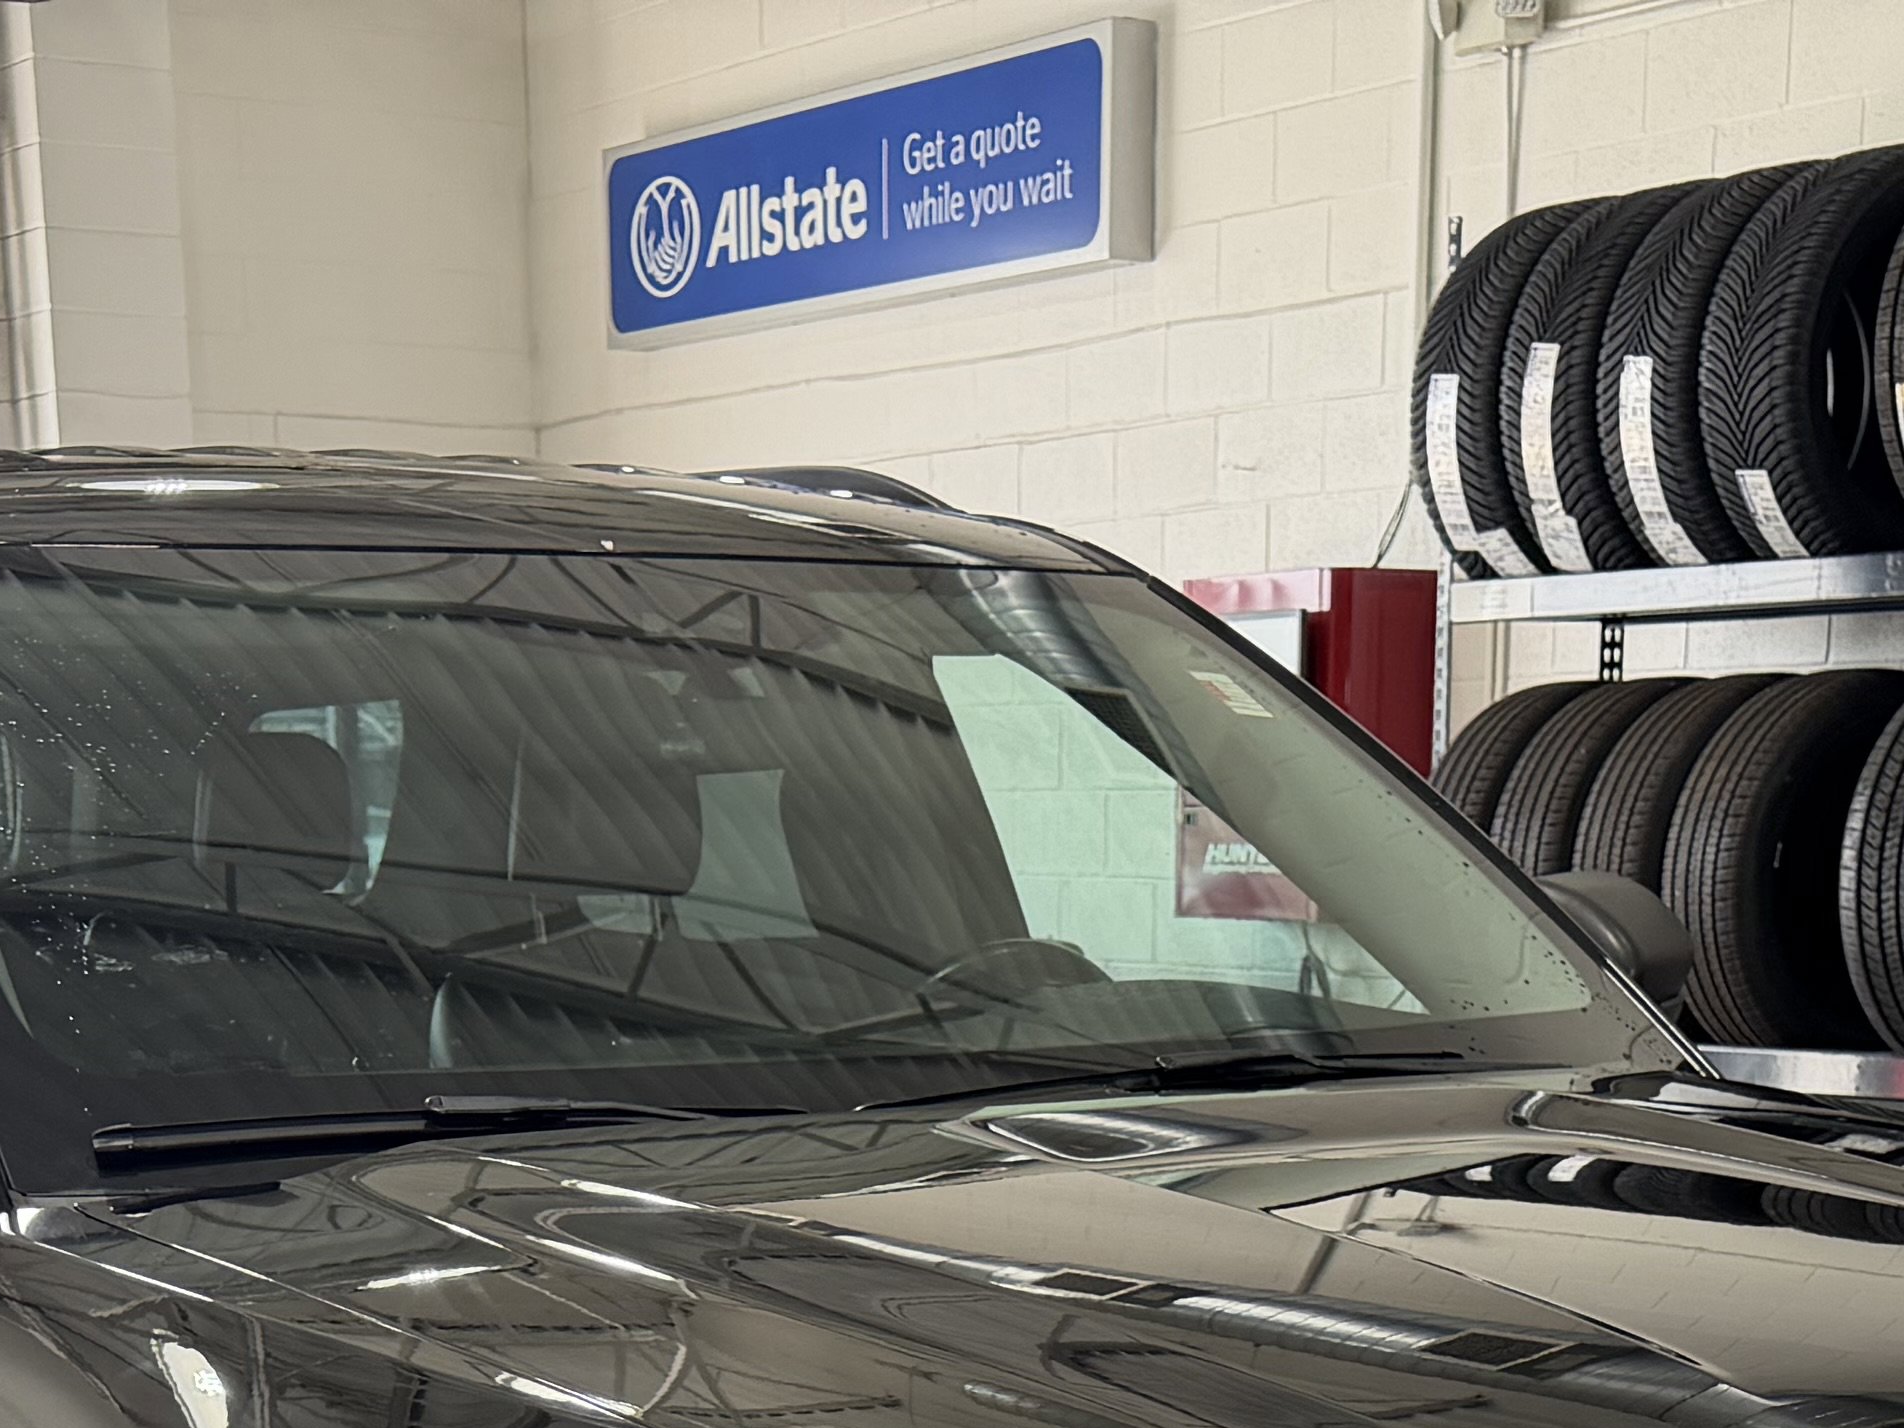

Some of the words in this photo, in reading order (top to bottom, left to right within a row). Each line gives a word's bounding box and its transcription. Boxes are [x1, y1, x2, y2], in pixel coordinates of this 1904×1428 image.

[903, 130, 945, 175] Get
[950, 134, 965, 165] a
[970, 111, 1041, 168] quote
[705, 166, 868, 268] Allstate
[903, 181, 965, 230] while
[970, 181, 1013, 227] you
[1019, 159, 1073, 207] wait
